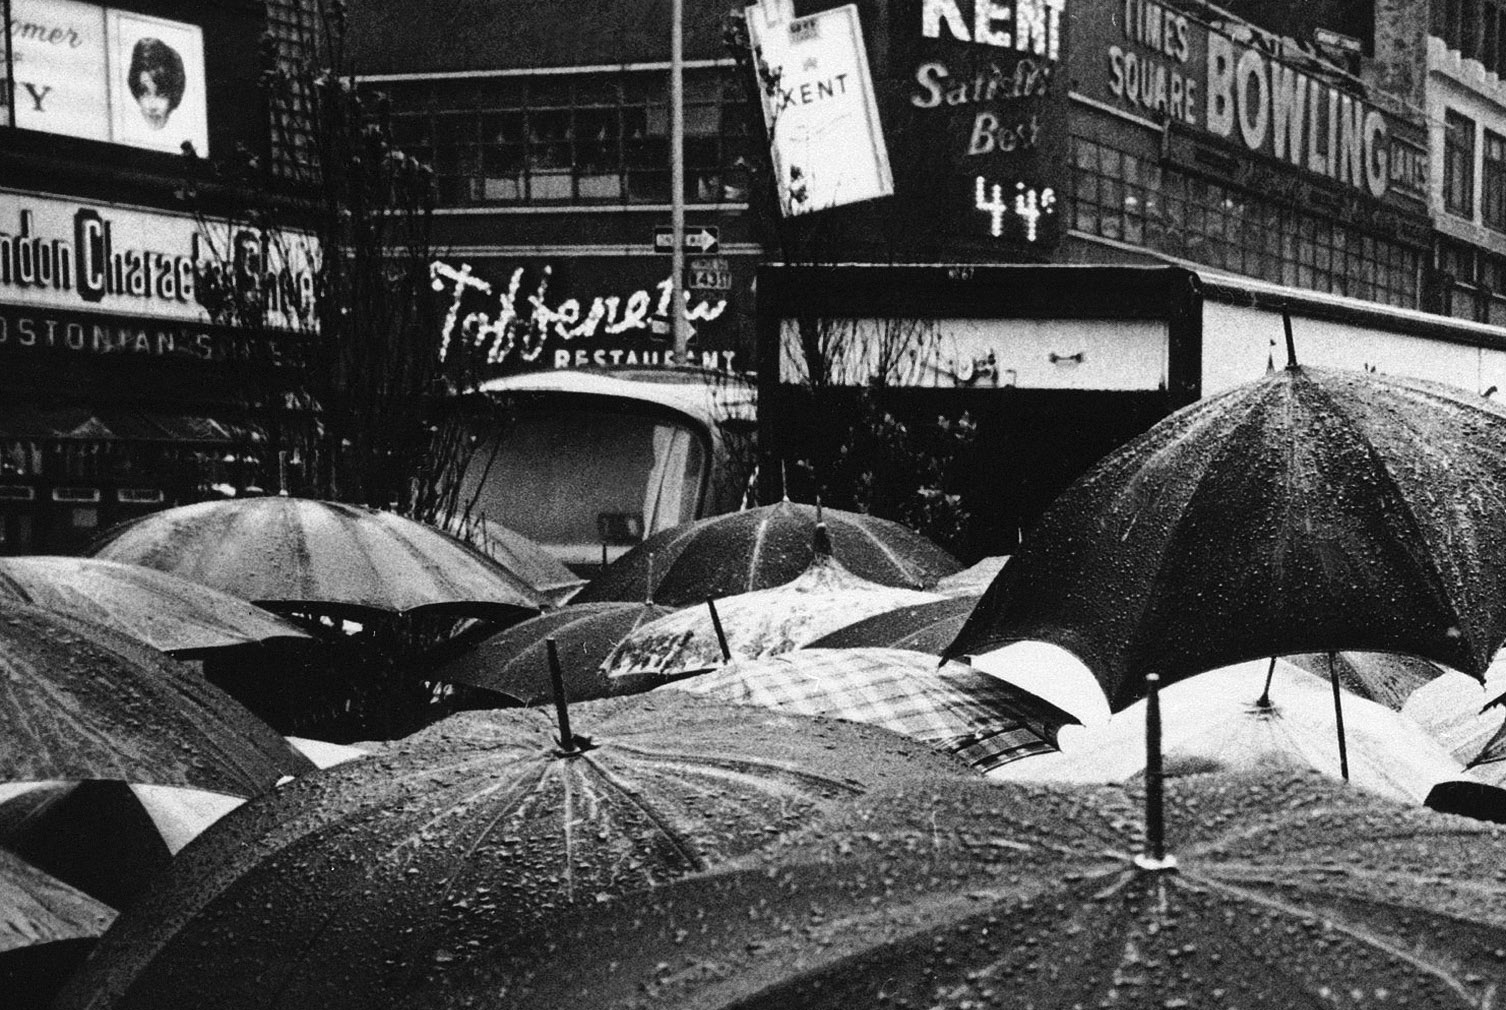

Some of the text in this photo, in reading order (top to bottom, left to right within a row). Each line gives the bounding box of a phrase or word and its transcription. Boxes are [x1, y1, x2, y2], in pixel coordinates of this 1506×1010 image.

[777, 73, 848, 111] KENT
[1109, 46, 1196, 124] SQUARE
[1207, 31, 1387, 198] BOWLING
